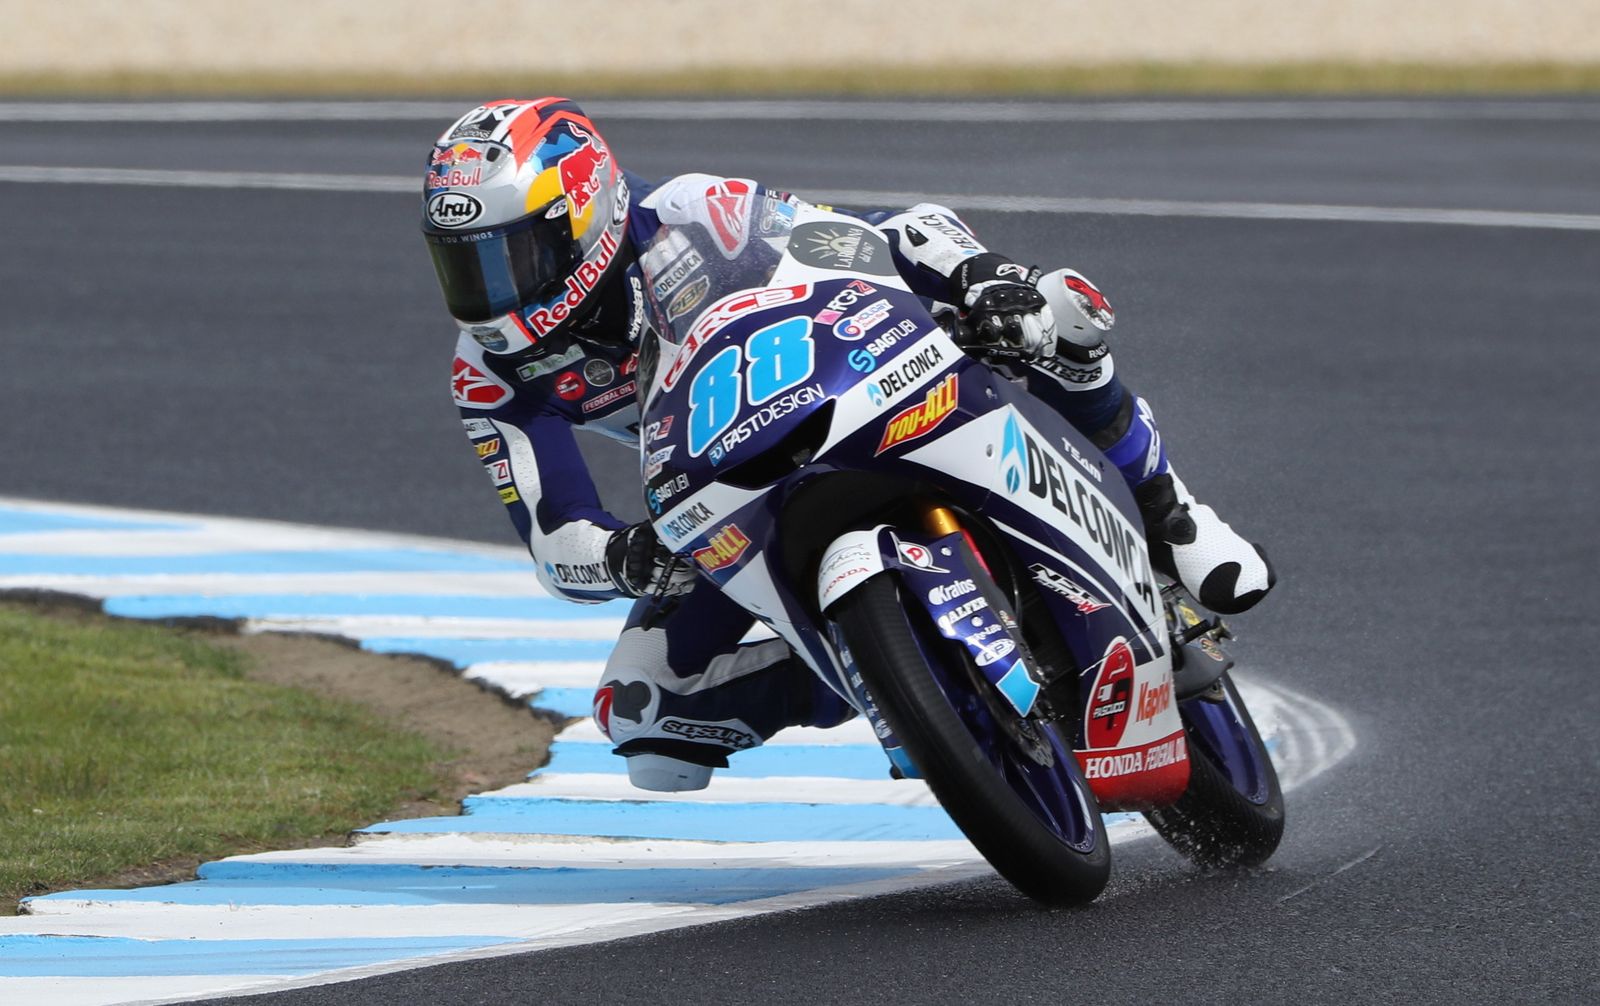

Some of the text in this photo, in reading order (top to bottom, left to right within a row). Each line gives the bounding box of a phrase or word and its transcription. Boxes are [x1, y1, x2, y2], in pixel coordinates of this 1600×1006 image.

[428, 167, 481, 189] Red Bull
[429, 197, 474, 218] Arai
[461, 230, 494, 242] WINGS
[529, 276, 587, 337] Red
[575, 229, 619, 292] Bull
[865, 319, 918, 357] SAGTUBI
[584, 391, 619, 411] FEDERAL
[886, 372, 959, 446] YOU-ALL
[1061, 437, 1103, 482] TEAM
[1085, 751, 1143, 779] HONDA
